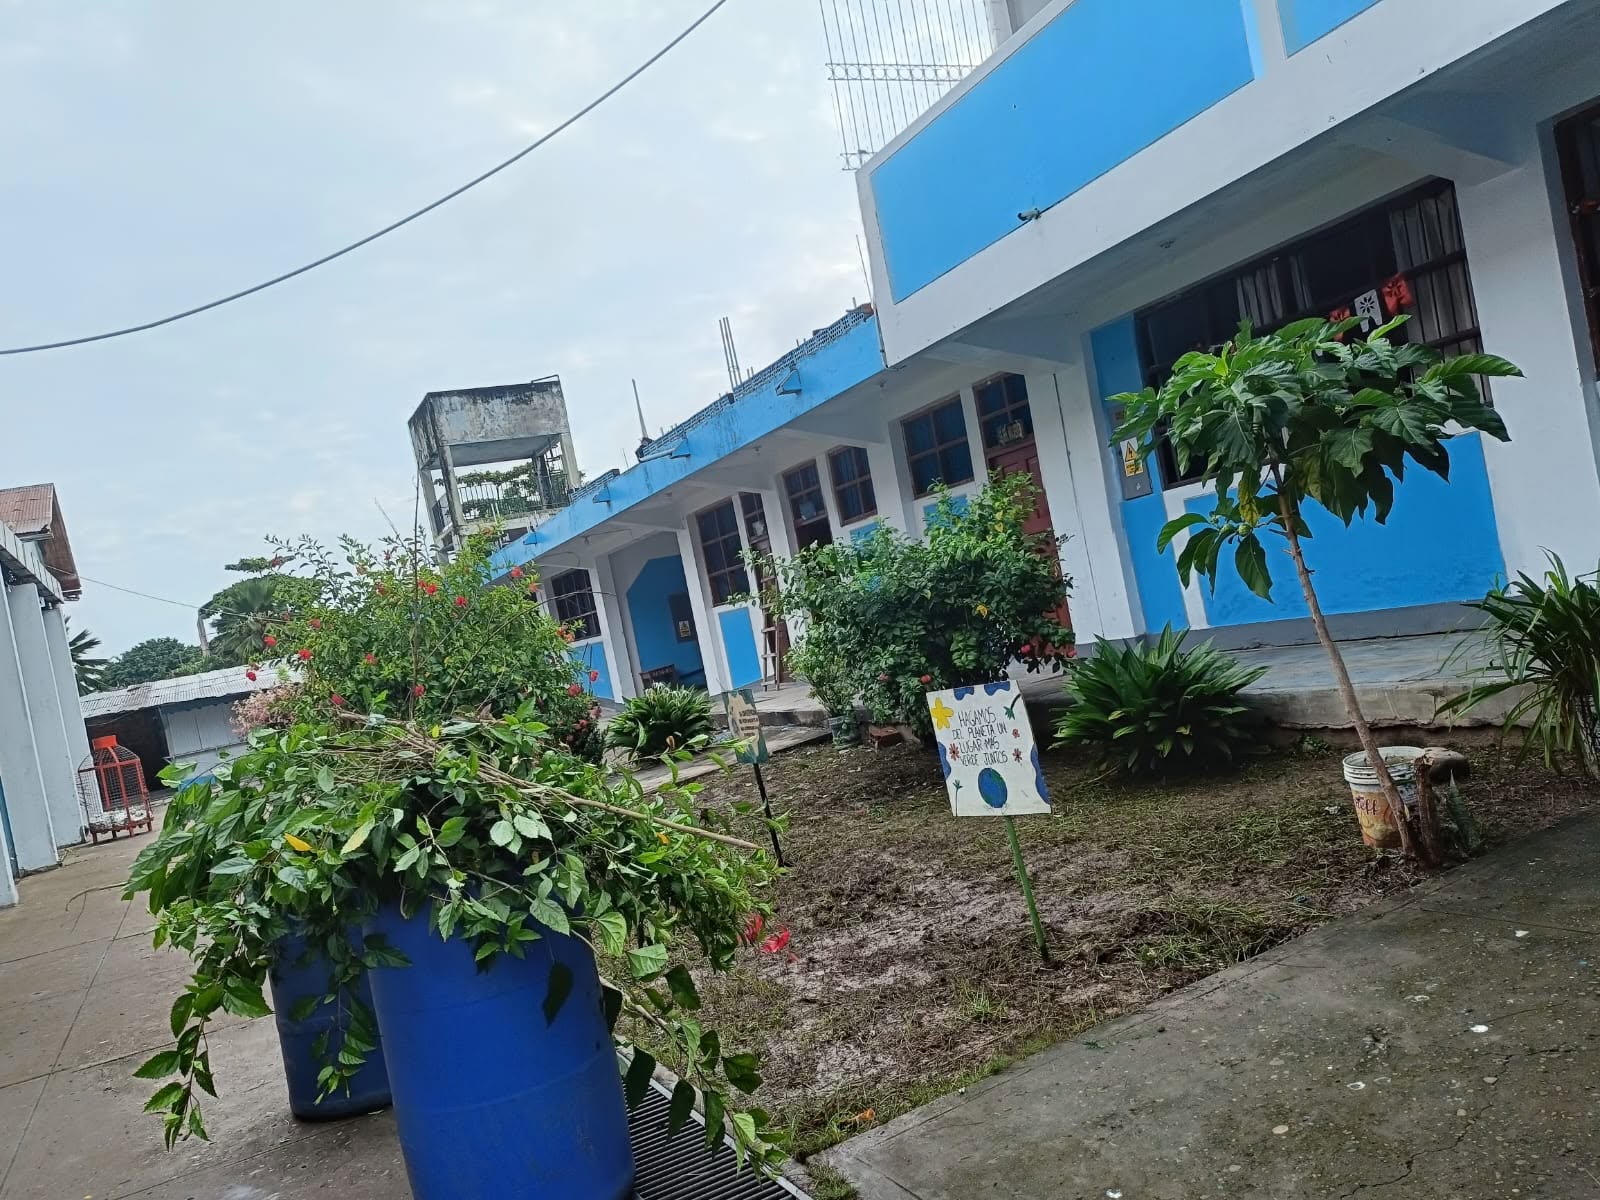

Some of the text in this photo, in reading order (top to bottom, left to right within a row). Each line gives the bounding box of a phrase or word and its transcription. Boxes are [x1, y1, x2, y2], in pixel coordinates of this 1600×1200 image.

[958, 707, 997, 727] HAGAMOS
[952, 721, 1008, 740] DEL PLANETA UN
[959, 739, 983, 754] LUGAR
[960, 751, 1008, 767] VERDE JUNTOS
